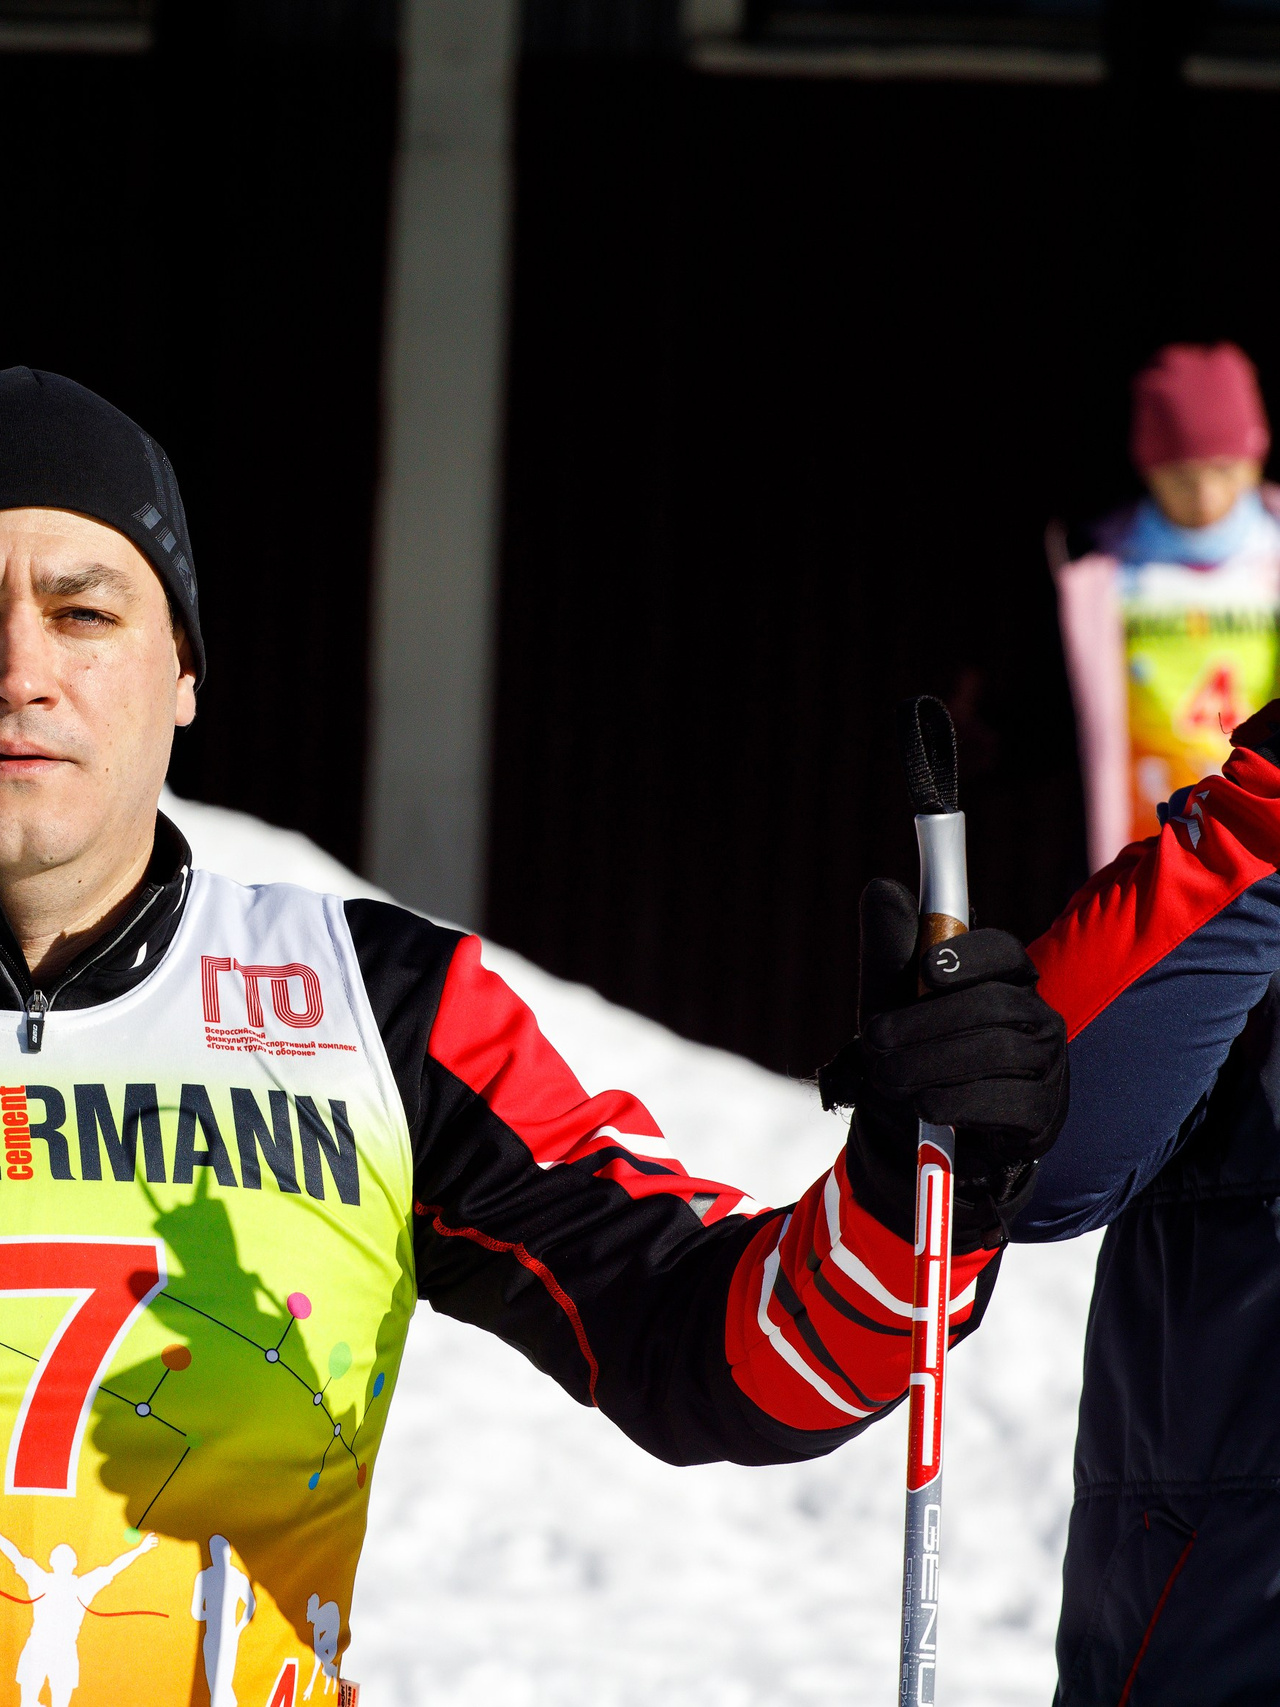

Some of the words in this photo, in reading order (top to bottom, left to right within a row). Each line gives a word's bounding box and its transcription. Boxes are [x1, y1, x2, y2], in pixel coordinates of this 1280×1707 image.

[201, 955, 324, 1029] ГТО
[318, 1042, 357, 1052] комплекс
[903, 1558, 913, 1654] CARBON
